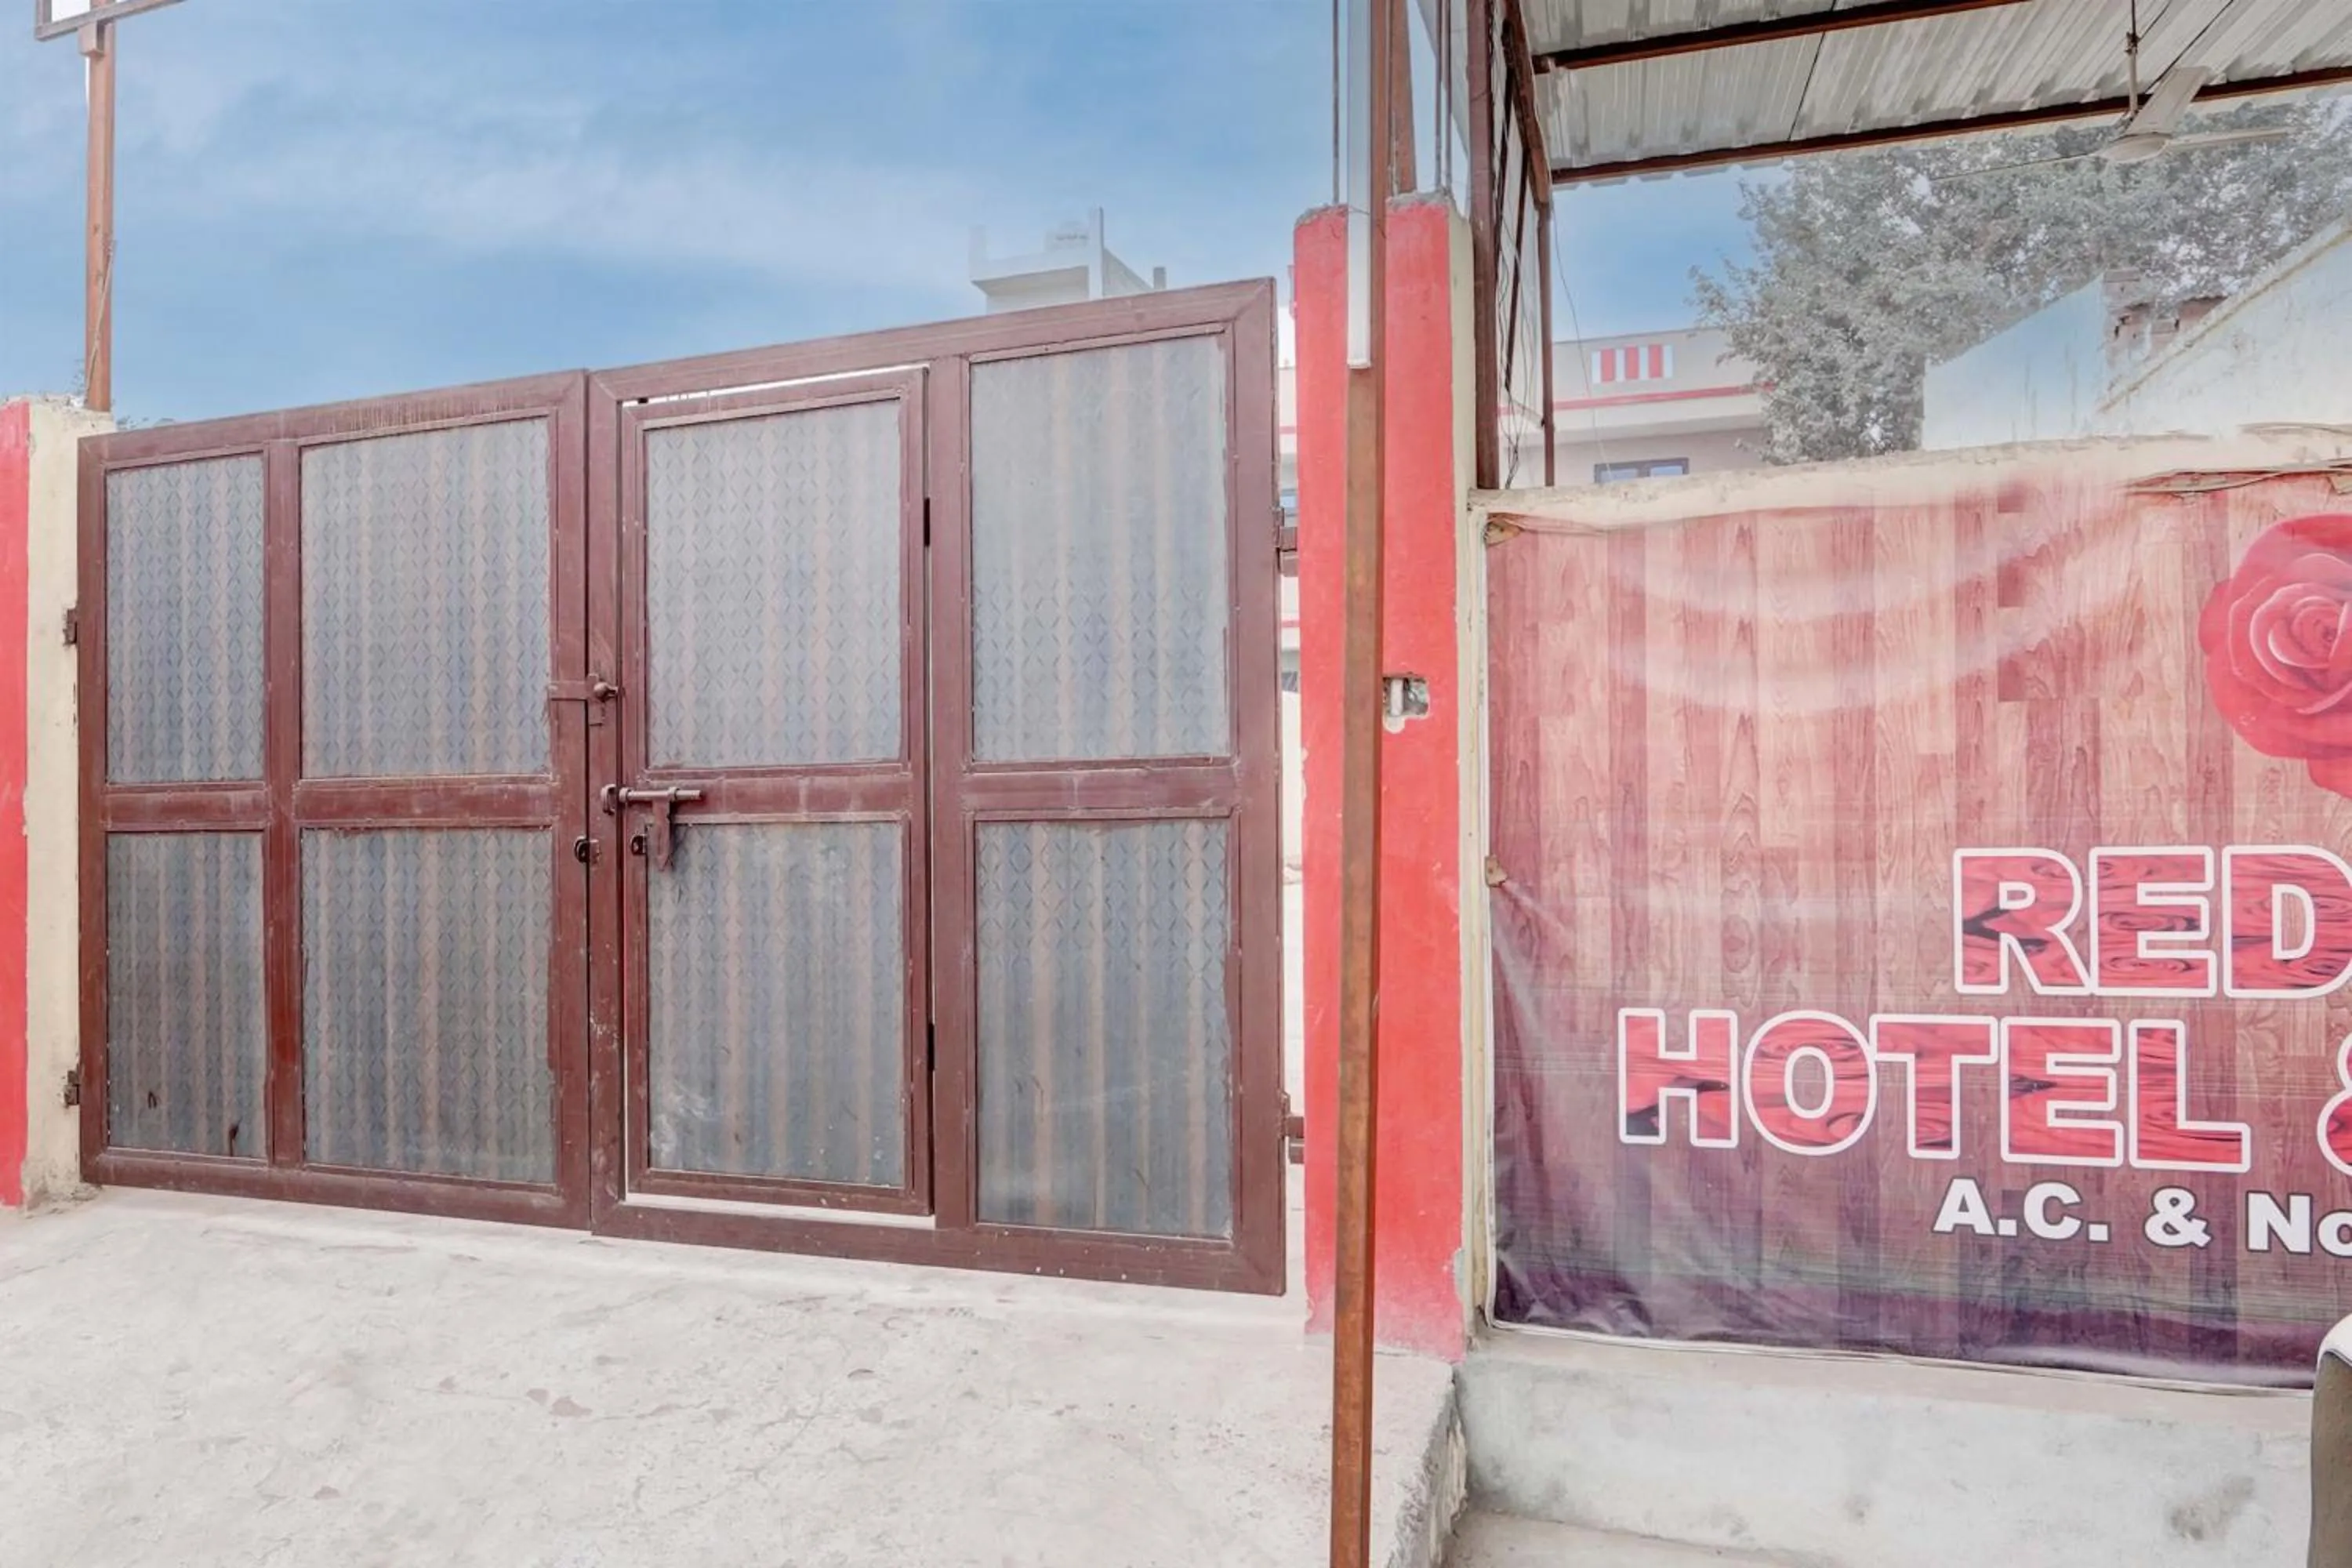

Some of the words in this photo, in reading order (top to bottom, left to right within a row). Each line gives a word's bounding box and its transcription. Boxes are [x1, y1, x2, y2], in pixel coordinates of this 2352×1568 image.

[1954, 846, 2352, 998] RED
[1618, 1008, 2251, 1173] HOTEL
[1933, 1178, 2111, 1242] A.C.
[2143, 1185, 2213, 1249] &
